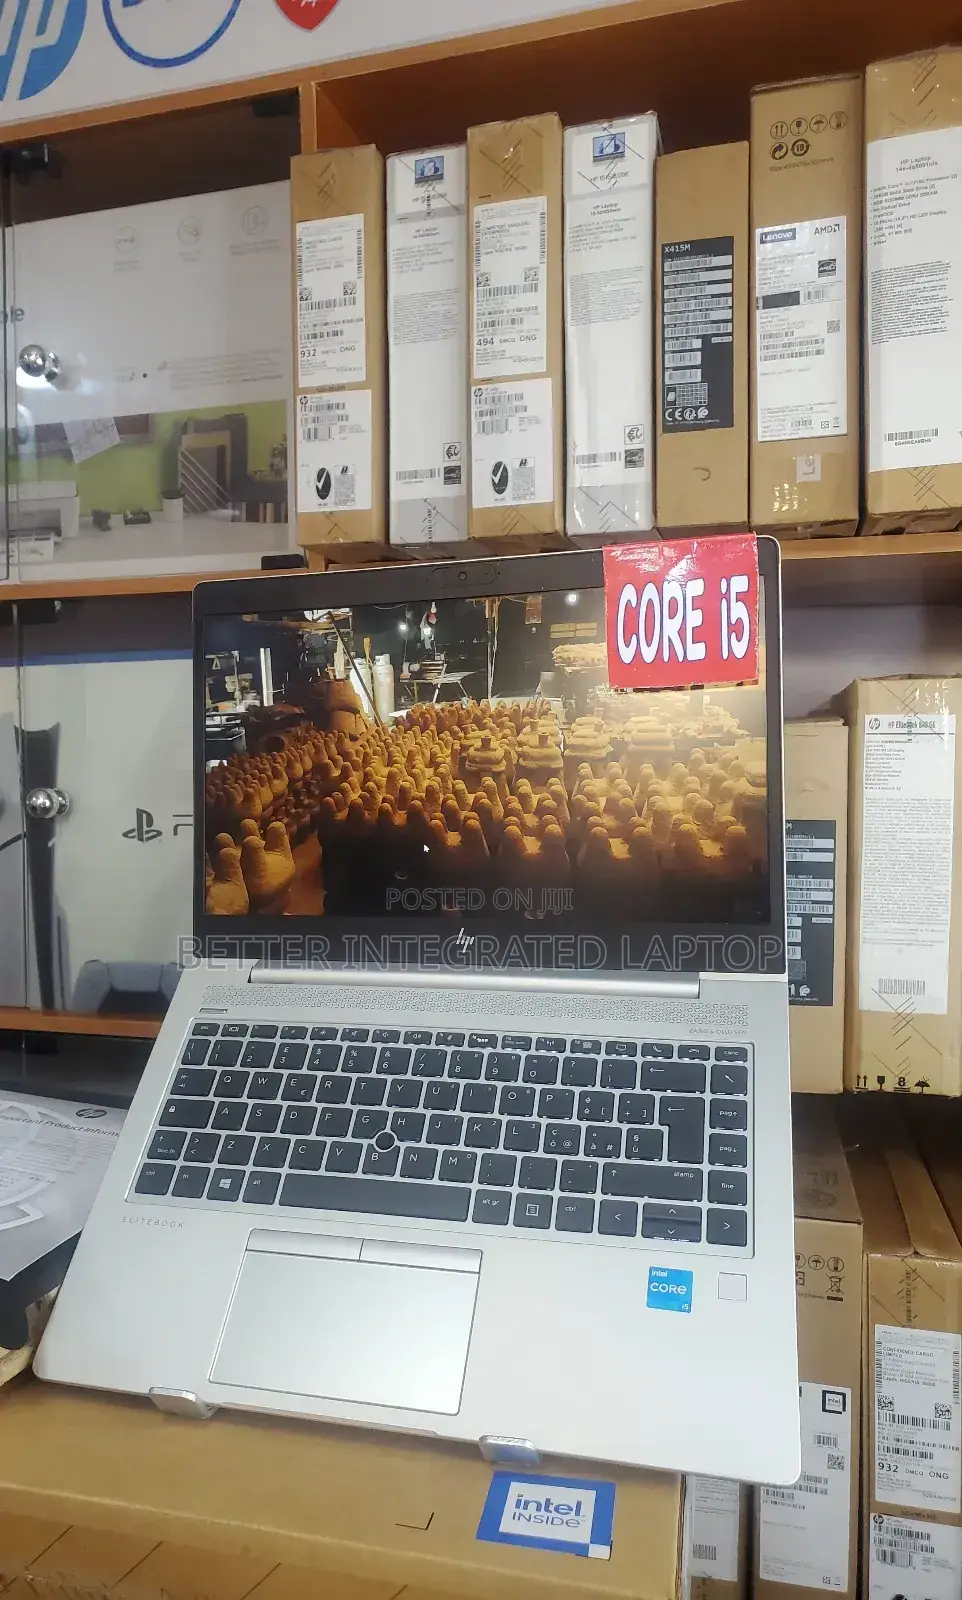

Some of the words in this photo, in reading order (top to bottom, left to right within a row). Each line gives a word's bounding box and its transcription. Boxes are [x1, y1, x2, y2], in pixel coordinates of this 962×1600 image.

[814, 224, 833, 236] AMD
[762, 231, 793, 242] Lenovo
[664, 244, 691, 254] X415M
[476, 336, 494, 346] 494
[300, 348, 316, 358] 932
[616, 577, 707, 664] CORE
[720, 574, 750, 661] i5
[324, 1080, 333, 1089] R
[432, 1086, 440, 1095] U
[508, 1092, 517, 1100] O
[546, 1094, 554, 1102] P
[44, 1120, 84, 1132] Product
[221, 1108, 230, 1116] A
[255, 1109, 263, 1117] S
[290, 1112, 298, 1120] D
[361, 1116, 370, 1124] G
[397, 1118, 406, 1126] H
[434, 1120, 442, 1128] J
[473, 1123, 482, 1132] K
[512, 1126, 518, 1135] L
[562, 1140, 572, 1148] @
[606, 1143, 614, 1151] #
[226, 1140, 236, 1149] Z
[262, 1144, 270, 1152] X
[298, 1146, 306, 1154] C
[335, 1148, 344, 1156] V
[370, 1152, 379, 1161] B
[409, 1154, 418, 1162] N
[448, 1157, 458, 1166] M
[674, 1171, 694, 1179] stamp
[122, 1216, 185, 1229] ELITEBOOK
[652, 1269, 668, 1278] intel
[878, 1461, 898, 1474] 932
[904, 1468, 924, 1476] DMCQ
[928, 1470, 949, 1480] ONG
[514, 1494, 583, 1517] intel
